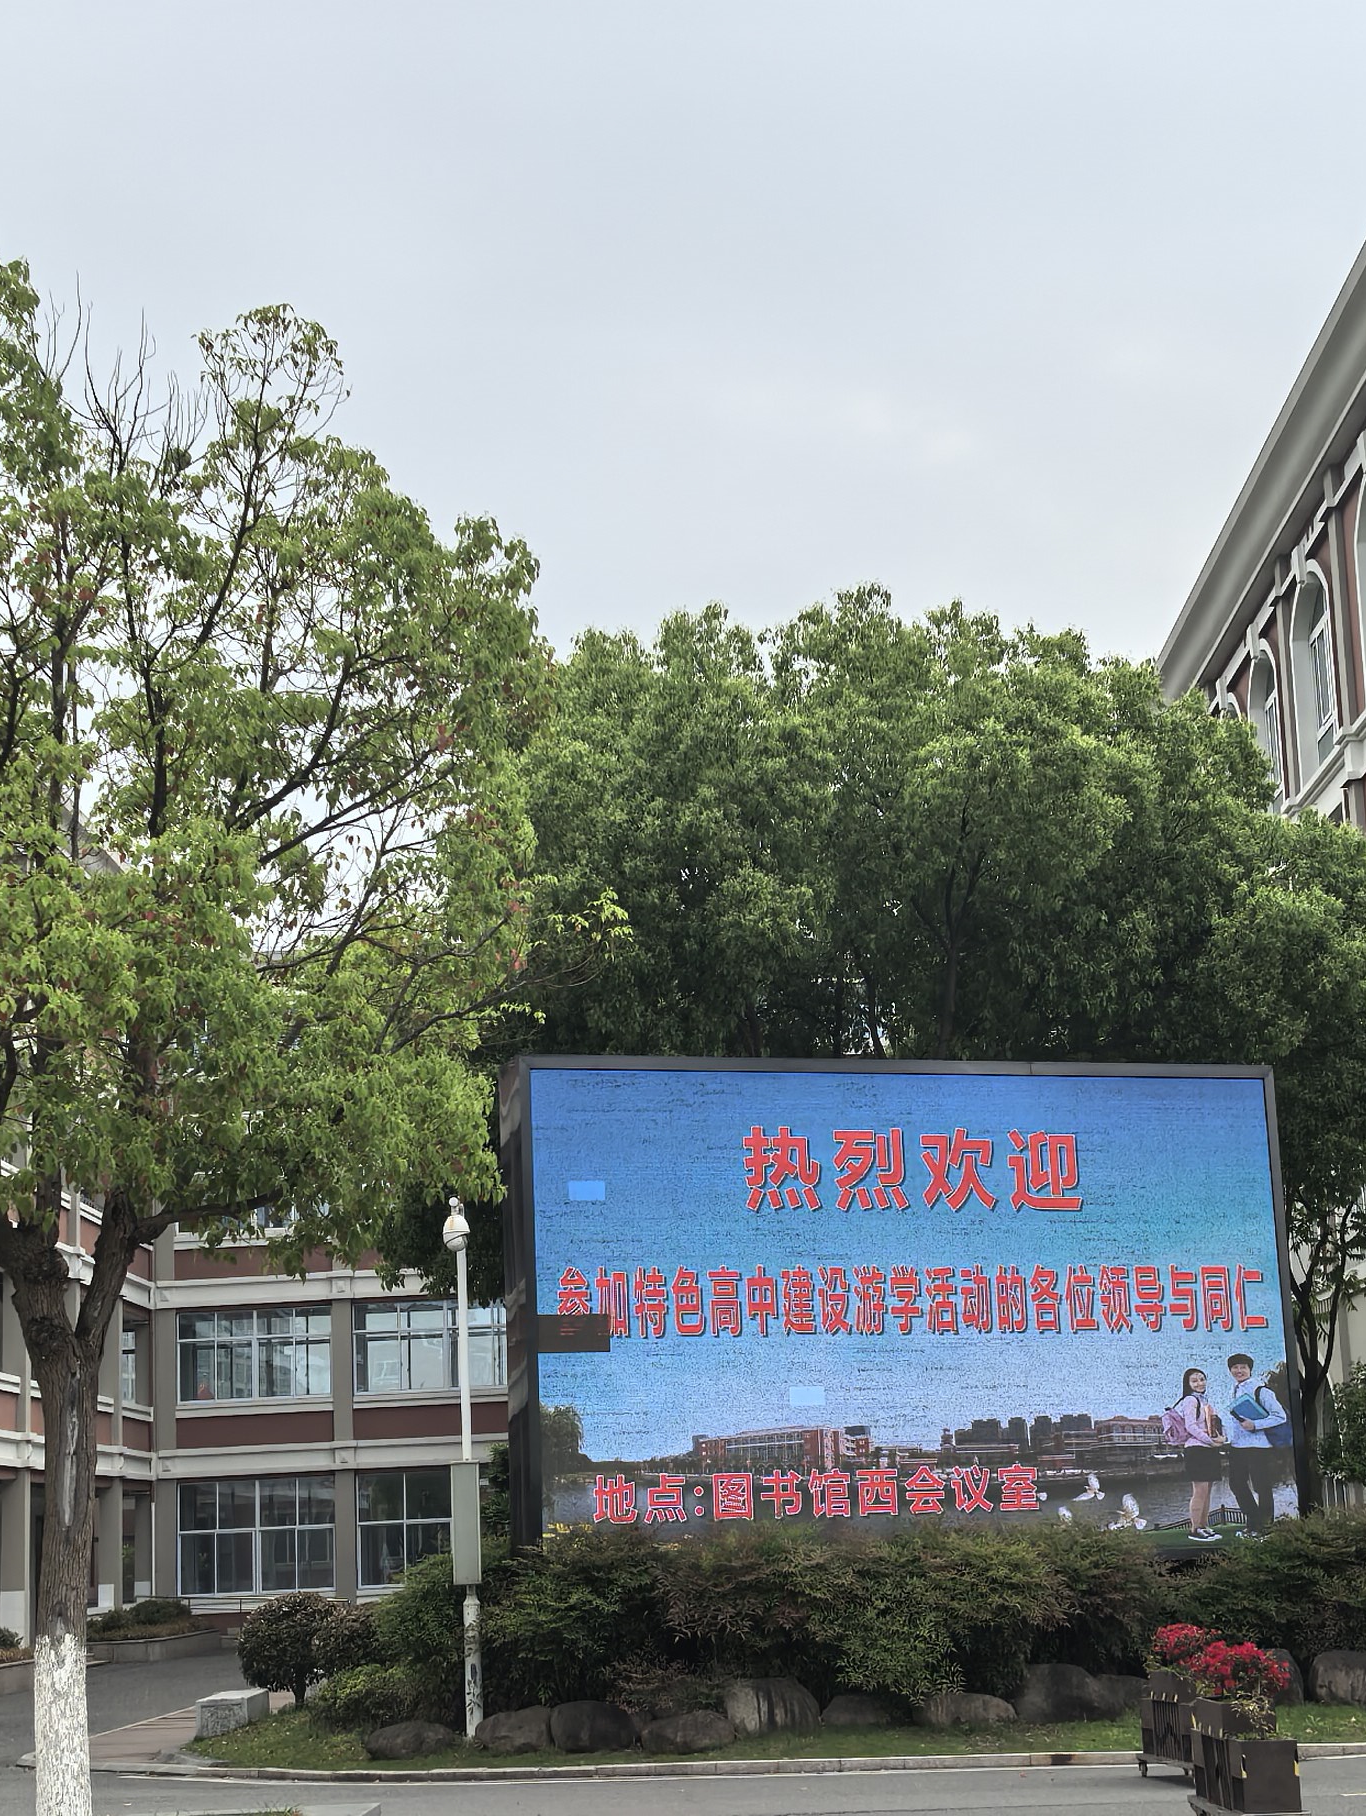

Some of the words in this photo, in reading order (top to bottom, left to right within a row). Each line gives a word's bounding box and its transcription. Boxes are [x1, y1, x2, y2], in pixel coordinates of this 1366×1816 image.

[742, 1124, 1085, 1213] 热烈欢迎
[556, 1263, 1269, 1338] 参加特色高中建设游学活动的各位领导与同仁
[592, 1464, 1041, 1526] 地点:图书馆西会议室
